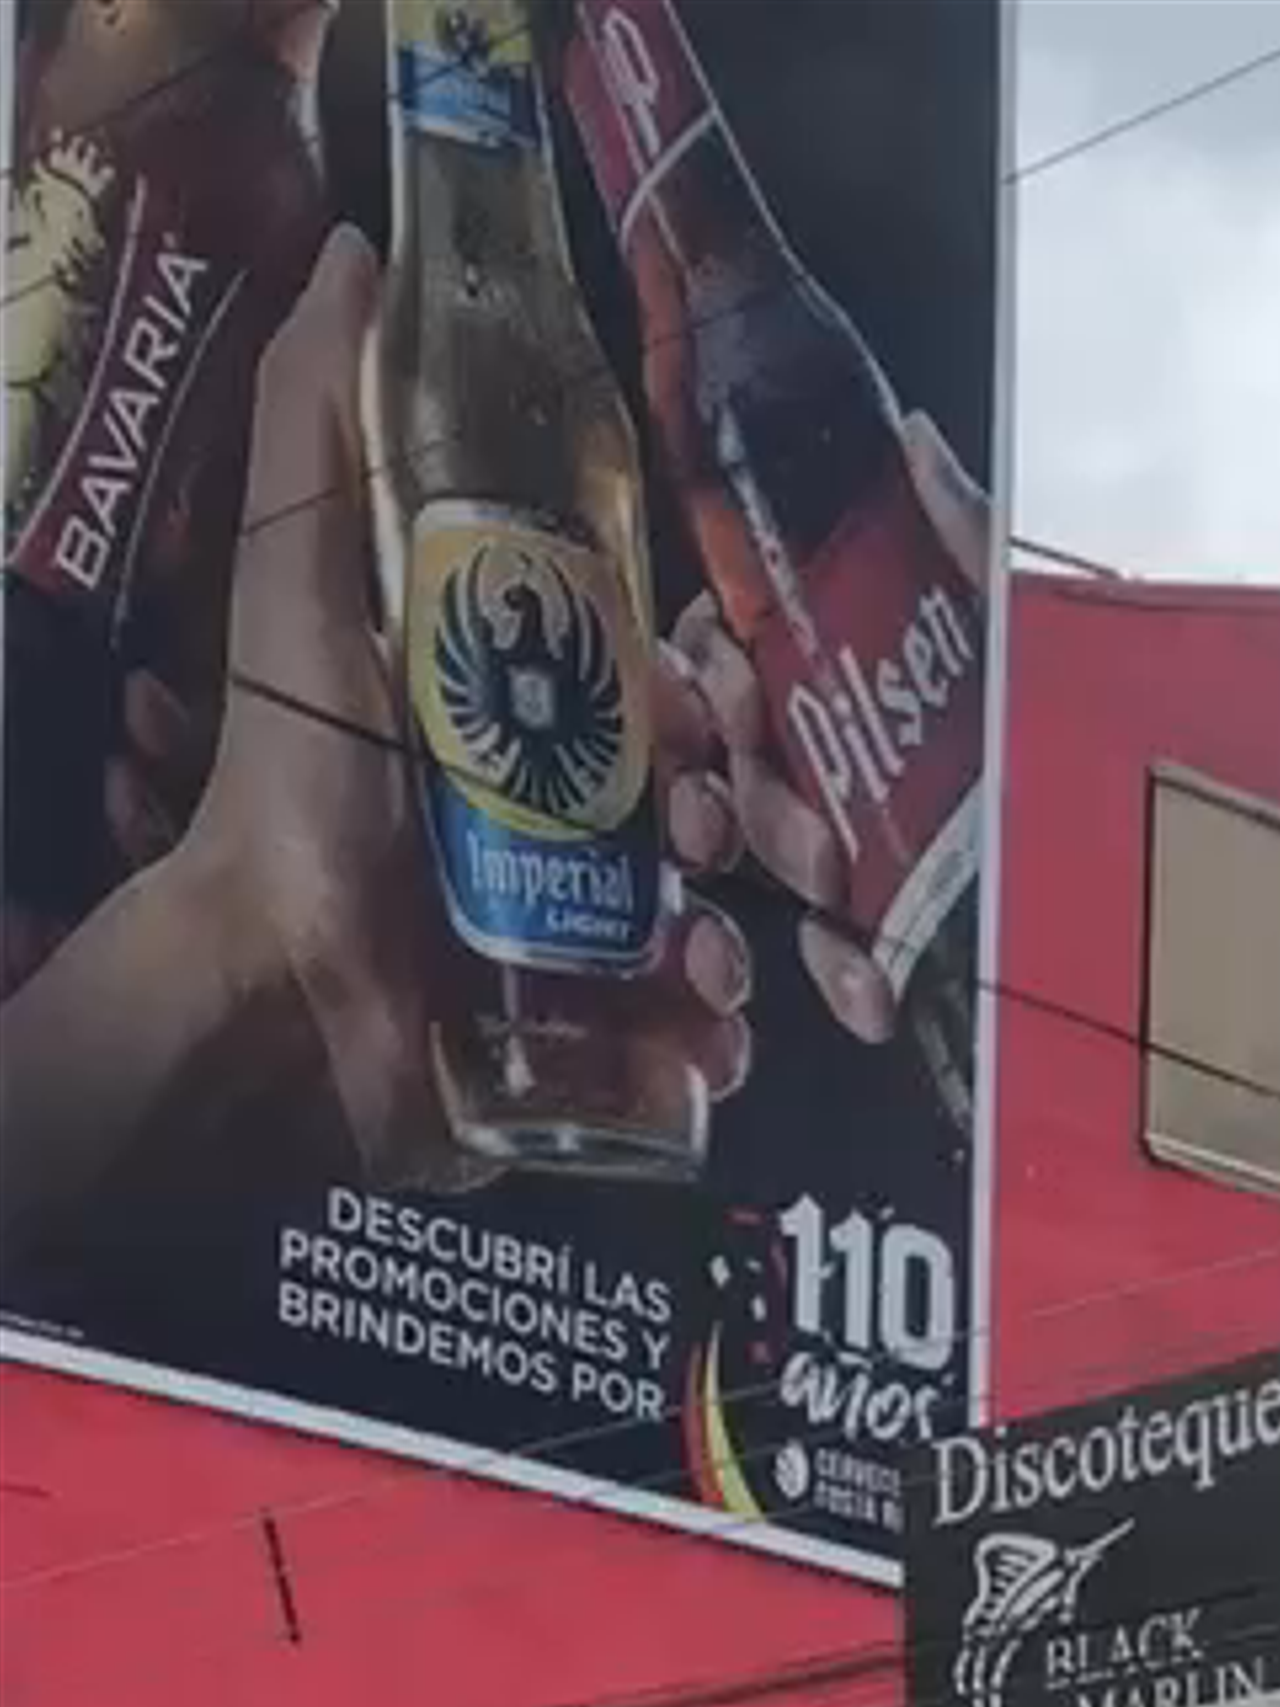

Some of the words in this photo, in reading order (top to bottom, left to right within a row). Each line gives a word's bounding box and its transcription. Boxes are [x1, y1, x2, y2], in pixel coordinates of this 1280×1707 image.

[54, 251, 208, 590] BAVARIA
[788, 585, 973, 863] Pilsen
[465, 828, 634, 912] Imperial
[546, 905, 633, 945] LIGHT
[280, 1228, 628, 1363] PROMOCIONES
[642, 1328, 671, 1371] Y
[328, 1184, 573, 1297] DESCUBRÍ
[584, 1261, 672, 1324] LAS
[779, 1194, 955, 1371] 110
[279, 1281, 557, 1394] BRINDEMOS
[573, 1361, 665, 1422] POR
[1045, 1607, 1206, 1690] BLACK
